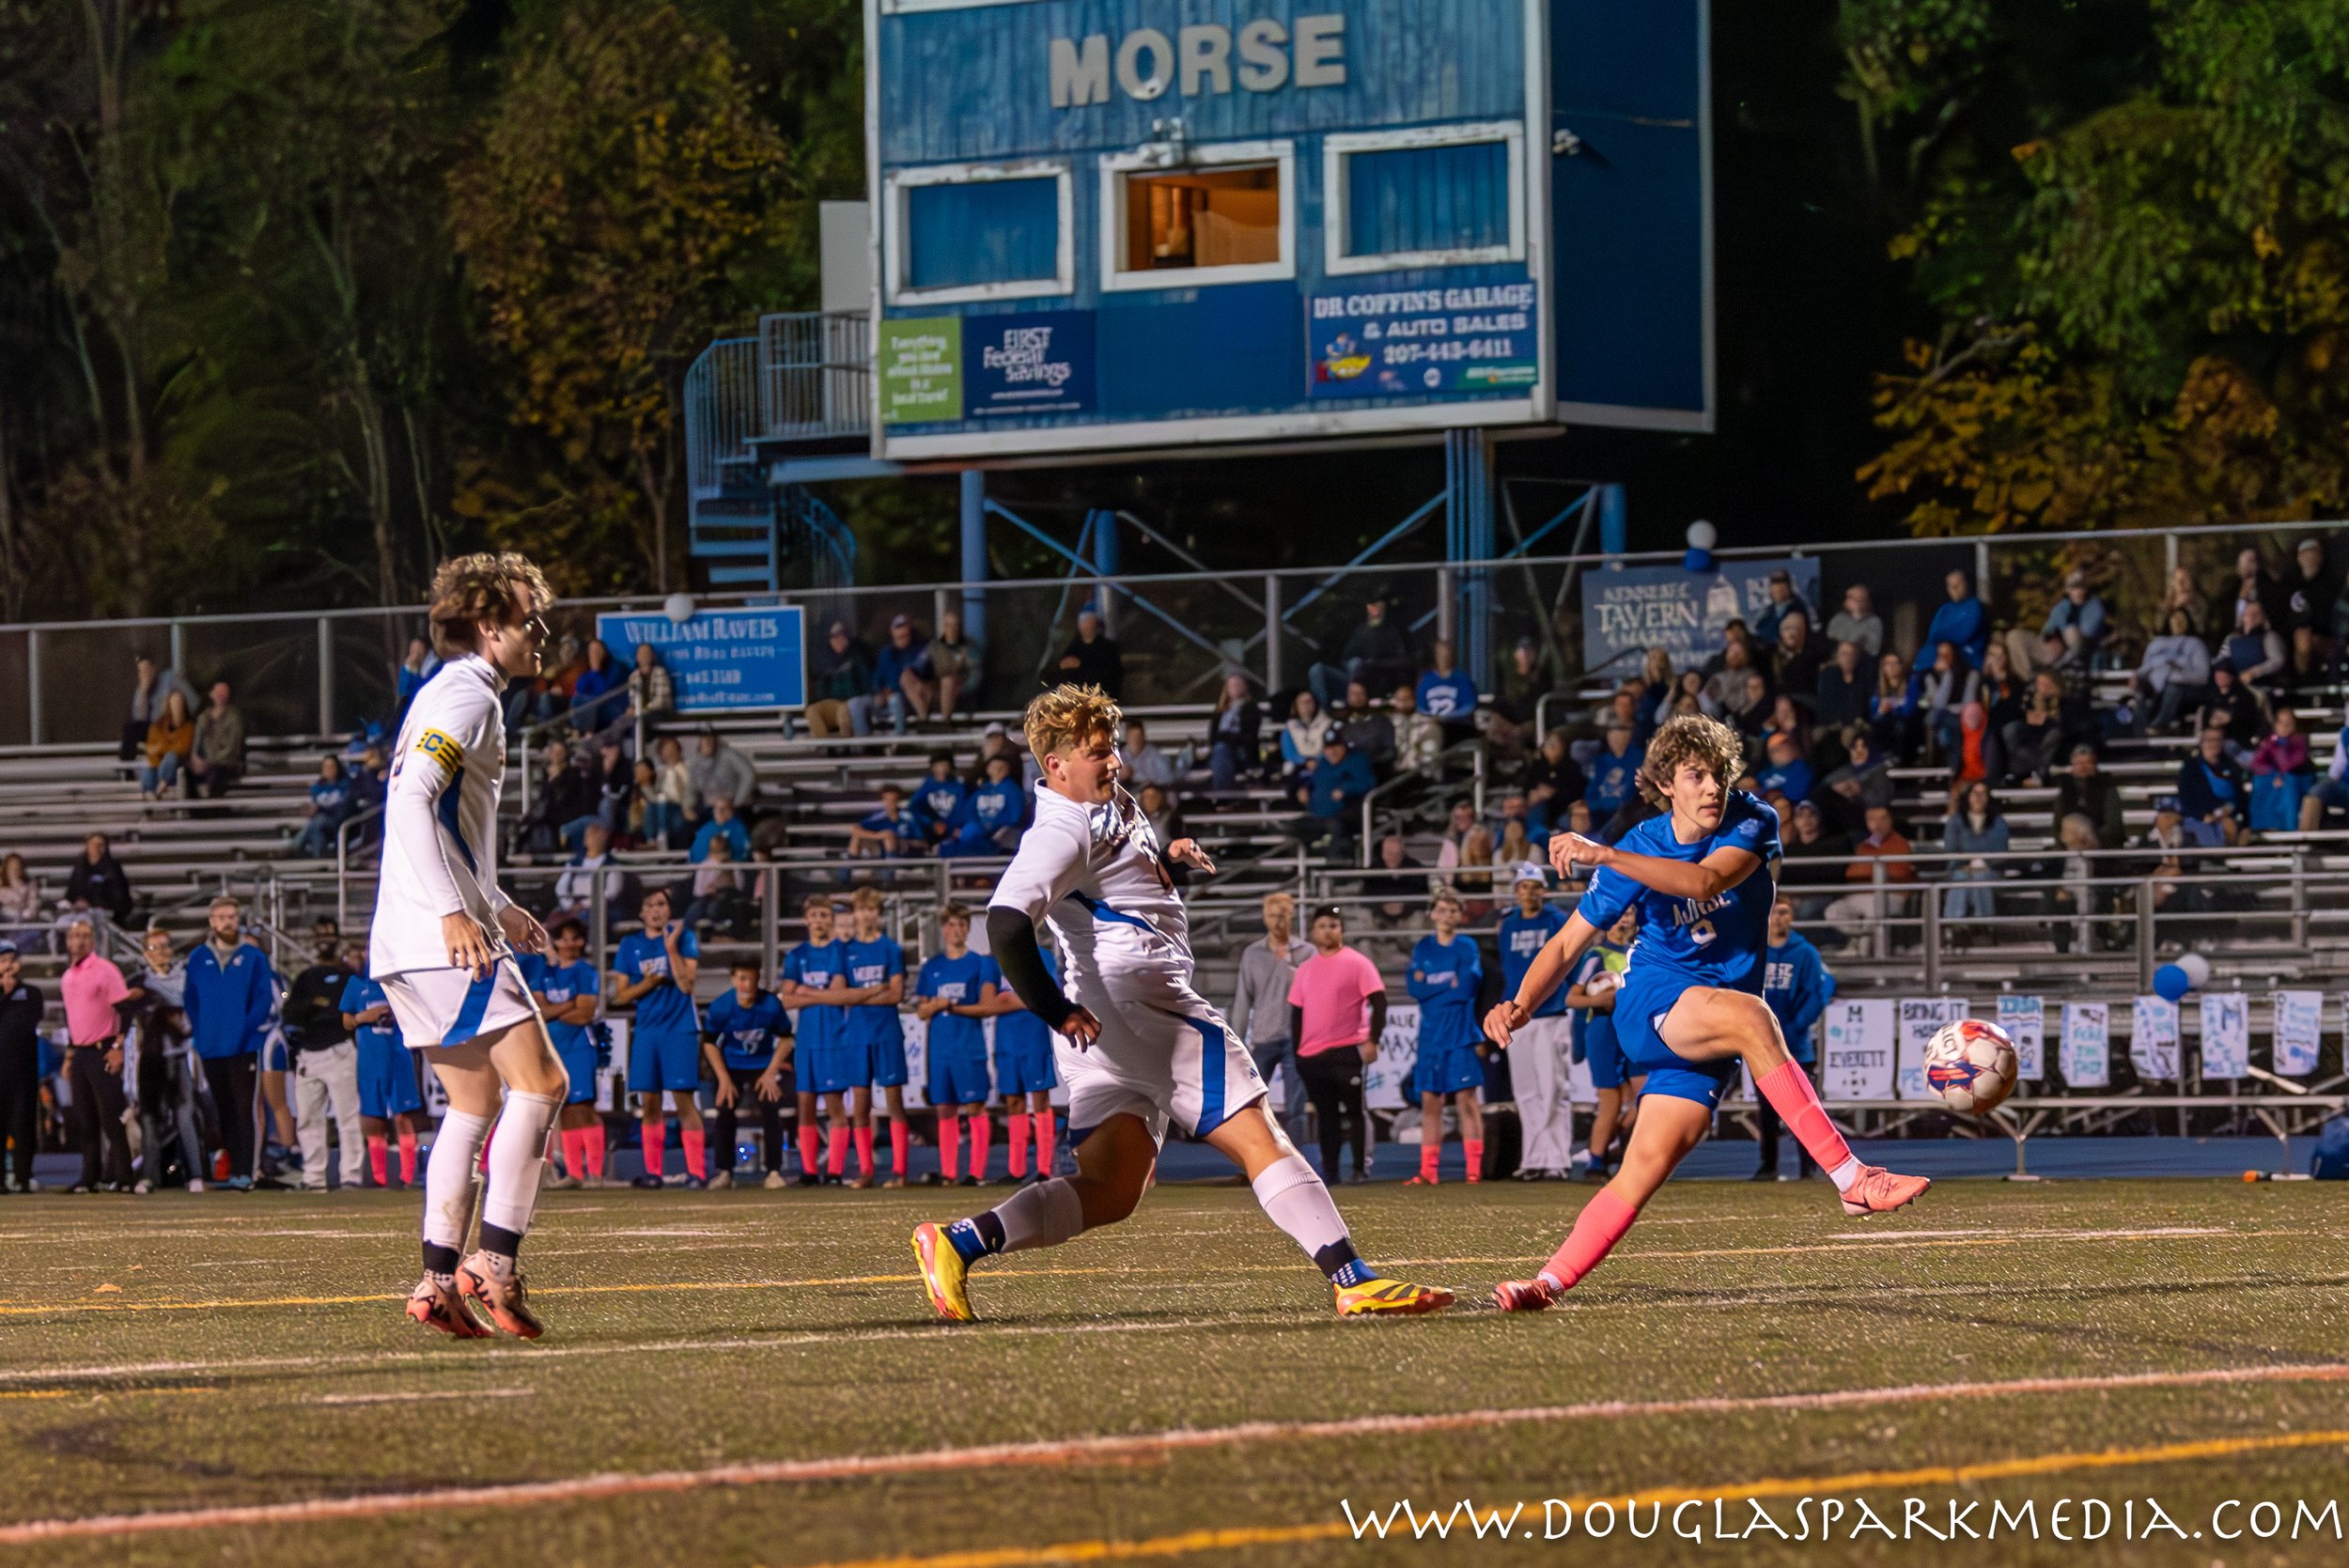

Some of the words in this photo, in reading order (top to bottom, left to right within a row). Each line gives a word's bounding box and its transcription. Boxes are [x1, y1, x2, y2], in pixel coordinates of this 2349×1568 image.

[1050, 14, 1346, 109] MORSE
[1445, 284, 1534, 310] GARAGE
[1003, 327, 1052, 349] FIRST
[1363, 323, 1382, 340] &
[1387, 318, 1448, 337] AUTO
[1453, 313, 1527, 334] SALES
[1594, 599, 1699, 633] TAVERN
[624, 618, 709, 644] WILLIAM
[713, 617, 778, 641] RAVEIS
[424, 733, 443, 753] C
[1949, 1002, 1965, 1020] IT
